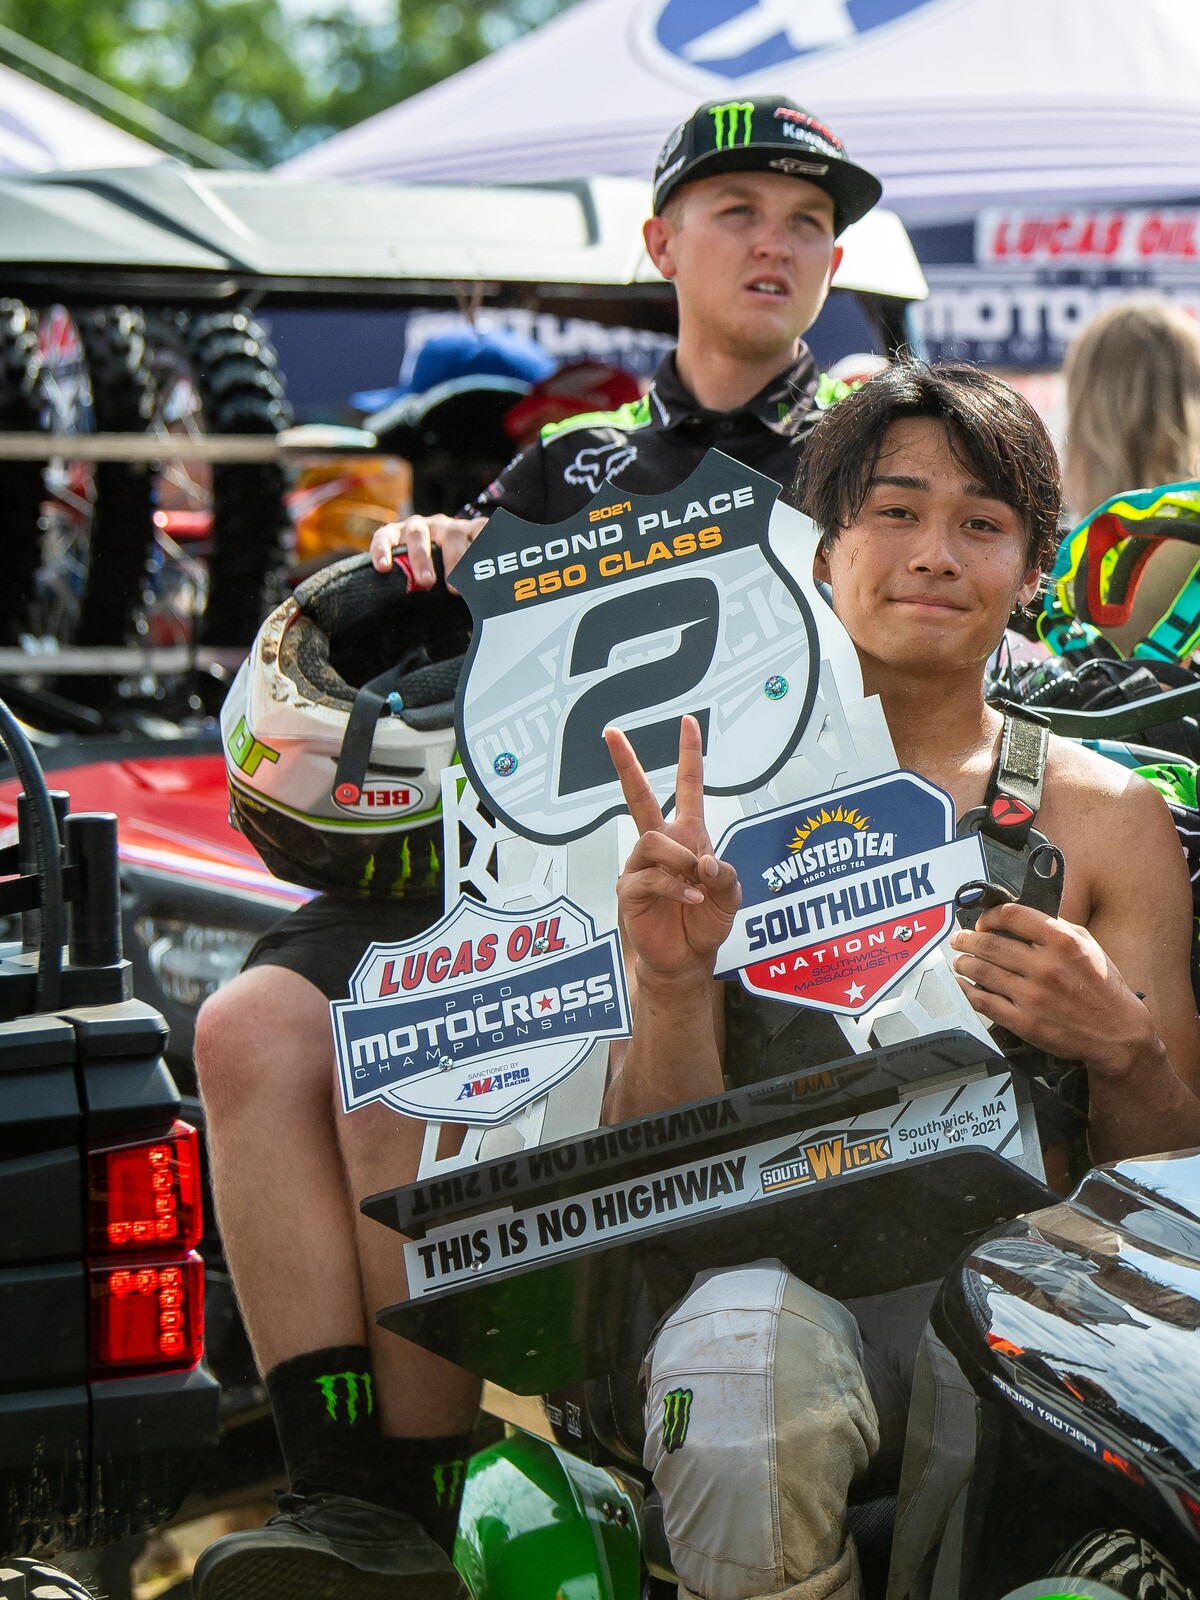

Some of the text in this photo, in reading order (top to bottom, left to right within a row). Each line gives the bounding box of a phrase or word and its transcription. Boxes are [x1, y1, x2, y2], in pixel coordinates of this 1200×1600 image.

[990, 211, 1128, 260] LUCAS
[588, 500, 632, 523] 2021
[473, 486, 755, 581] SECOND PLACE
[513, 525, 723, 602] 250 CLASS
[557, 576, 721, 797] 2
[352, 788, 411, 808] BEL
[761, 831, 895, 886] TWISTED TEA
[803, 860, 865, 884] HARD ICED TEA
[745, 862, 935, 952] SOUTHWICK
[379, 916, 565, 997] LUCAS OIL
[769, 919, 927, 978] NATIONAL
[811, 946, 889, 977] SOUTHWICK
[793, 949, 910, 992] MASSACHUSETTS
[351, 973, 613, 1068] MOTOCROSS
[446, 986, 512, 1012] PRO
[355, 1002, 615, 1079] CHAMPIONSHIP
[455, 1067, 529, 1101] AMA PRO
[467, 1064, 508, 1080] SANCTIONED
[505, 1078, 530, 1088] RACING
[898, 1101, 1007, 1142] Southwick, MA
[909, 1136, 940, 1155] July
[971, 1118, 1002, 1137] 2021
[762, 1160, 809, 1186] SOUTH
[417, 1155, 747, 1279] THIS IS NO HIGHWAY
